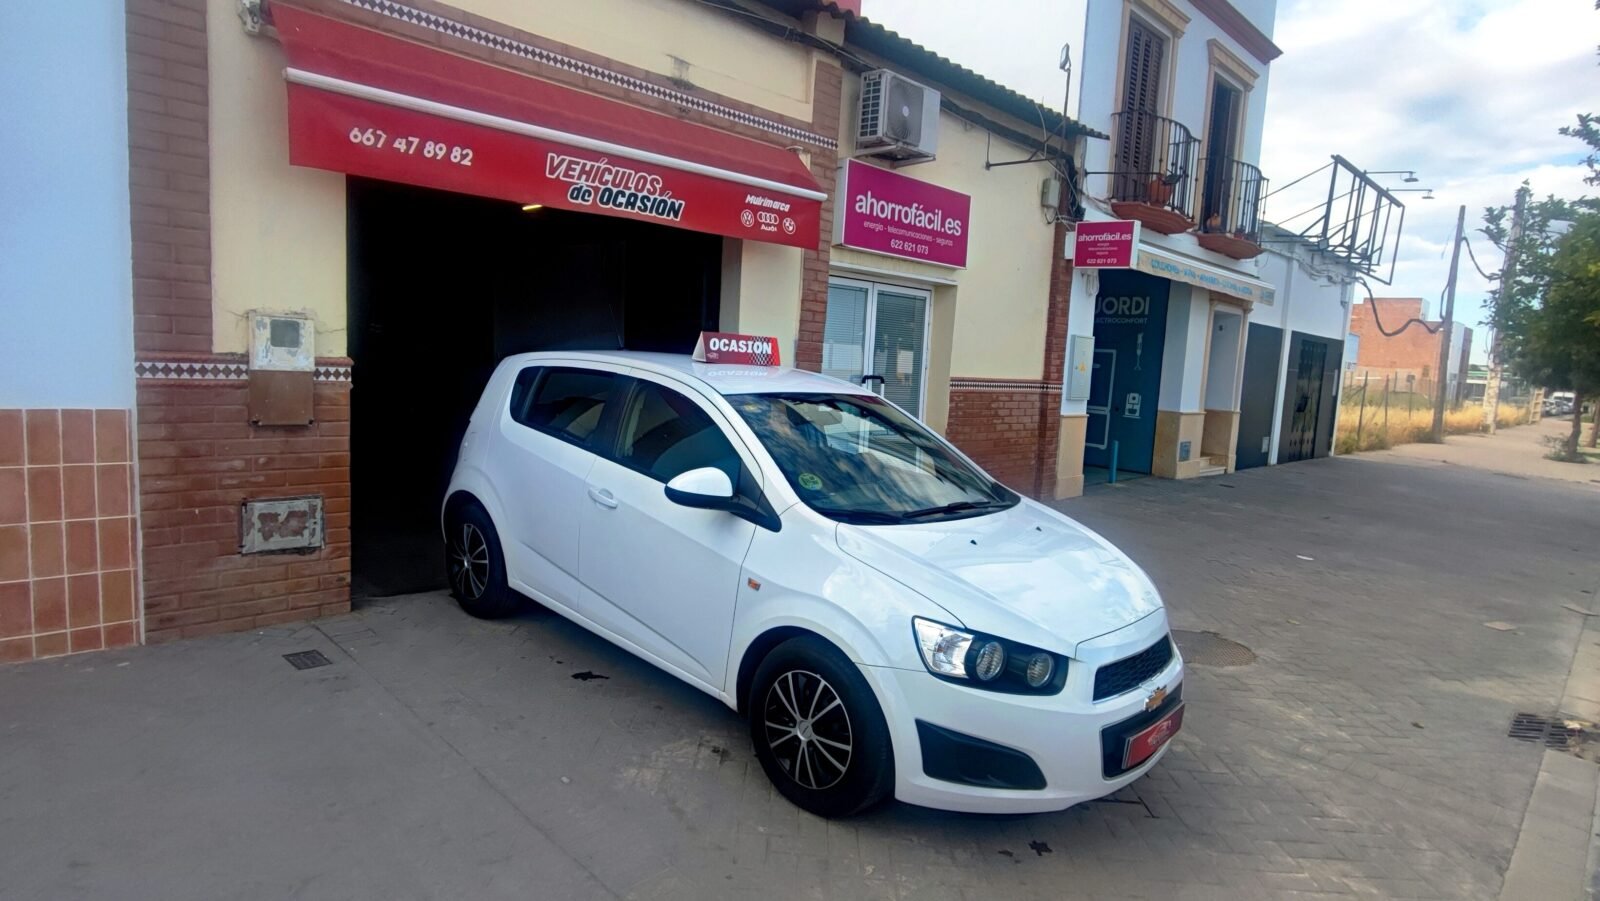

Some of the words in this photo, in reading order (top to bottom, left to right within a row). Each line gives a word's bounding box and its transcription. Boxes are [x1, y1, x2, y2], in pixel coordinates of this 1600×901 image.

[349, 127, 387, 149] 667
[393, 136, 420, 155] 47
[423, 141, 447, 160] 89
[450, 146, 473, 166] 82
[546, 153, 662, 196] VEHÍCULOS
[568, 184, 594, 205] de
[597, 186, 685, 221] OCASIÓN
[855, 190, 962, 236] ahorrofácil.es
[761, 224, 777, 232] Audi
[890, 239, 903, 250] 622
[904, 241, 916, 252] 621
[917, 243, 929, 255] 073
[1096, 296, 1150, 315] JORDI
